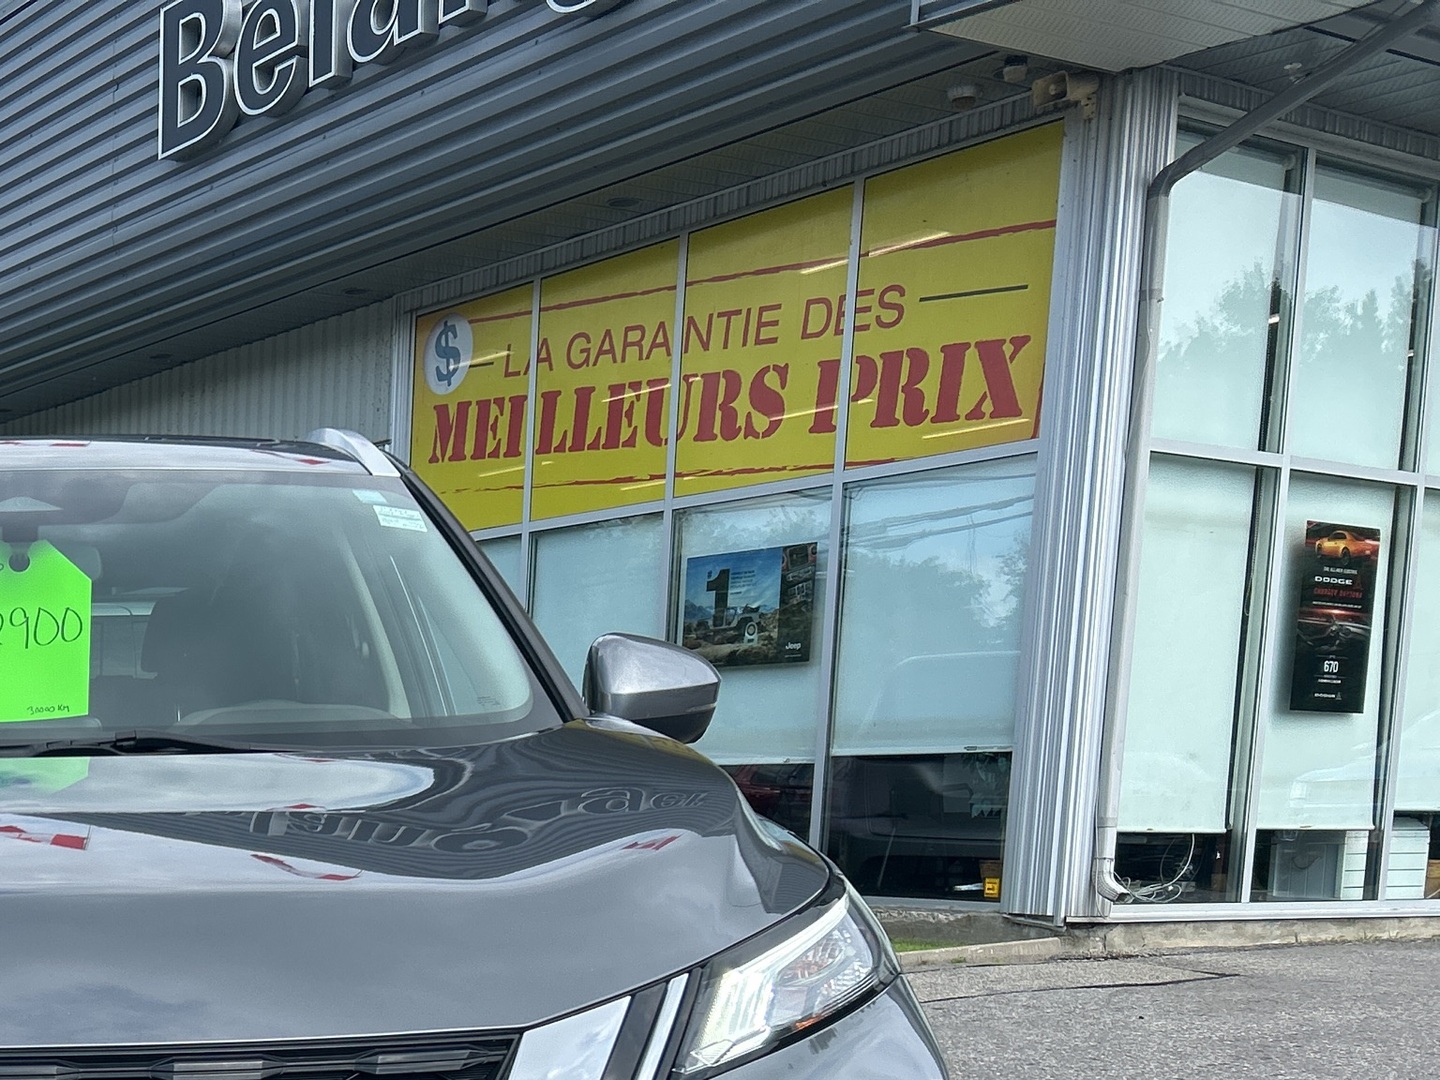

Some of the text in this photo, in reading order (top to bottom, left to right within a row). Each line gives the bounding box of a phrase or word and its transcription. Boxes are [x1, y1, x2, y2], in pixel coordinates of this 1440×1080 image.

[503, 283, 907, 378] LA GARANTIE DES
[427, 334, 1033, 466] MEILLEURS PRIX
[1314, 575, 1353, 586] DODGE
[785, 641, 802, 651] Jeep
[1323, 660, 1339, 673] 670
